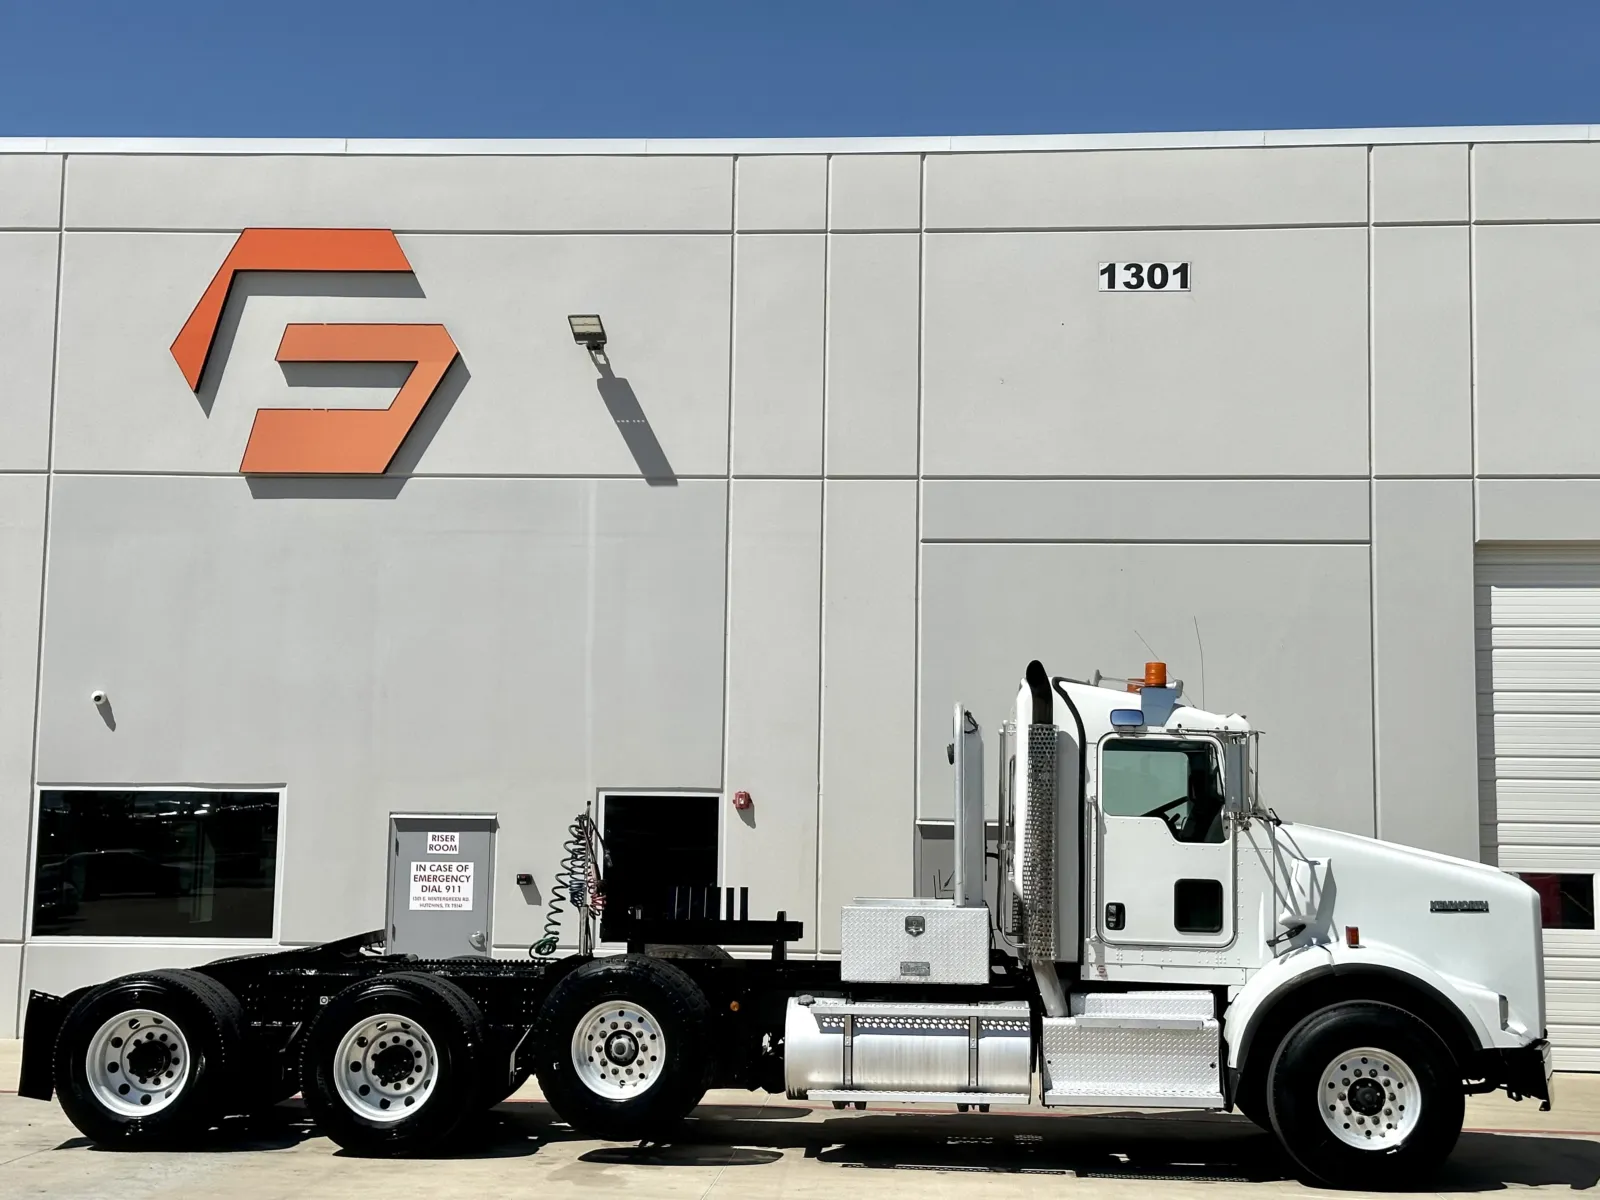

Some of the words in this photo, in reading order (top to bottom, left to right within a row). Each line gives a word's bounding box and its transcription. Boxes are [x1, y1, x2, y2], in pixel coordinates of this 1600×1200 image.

[1100, 262, 1188, 289] 1301
[431, 834, 456, 842] RISER
[428, 843, 458, 852] ROOM
[415, 864, 427, 872] IN
[429, 864, 453, 873] CASE
[456, 864, 470, 873] OF
[413, 874, 471, 883] EMERGENCY
[421, 884, 443, 893] DIAL
[445, 885, 461, 893] 911
